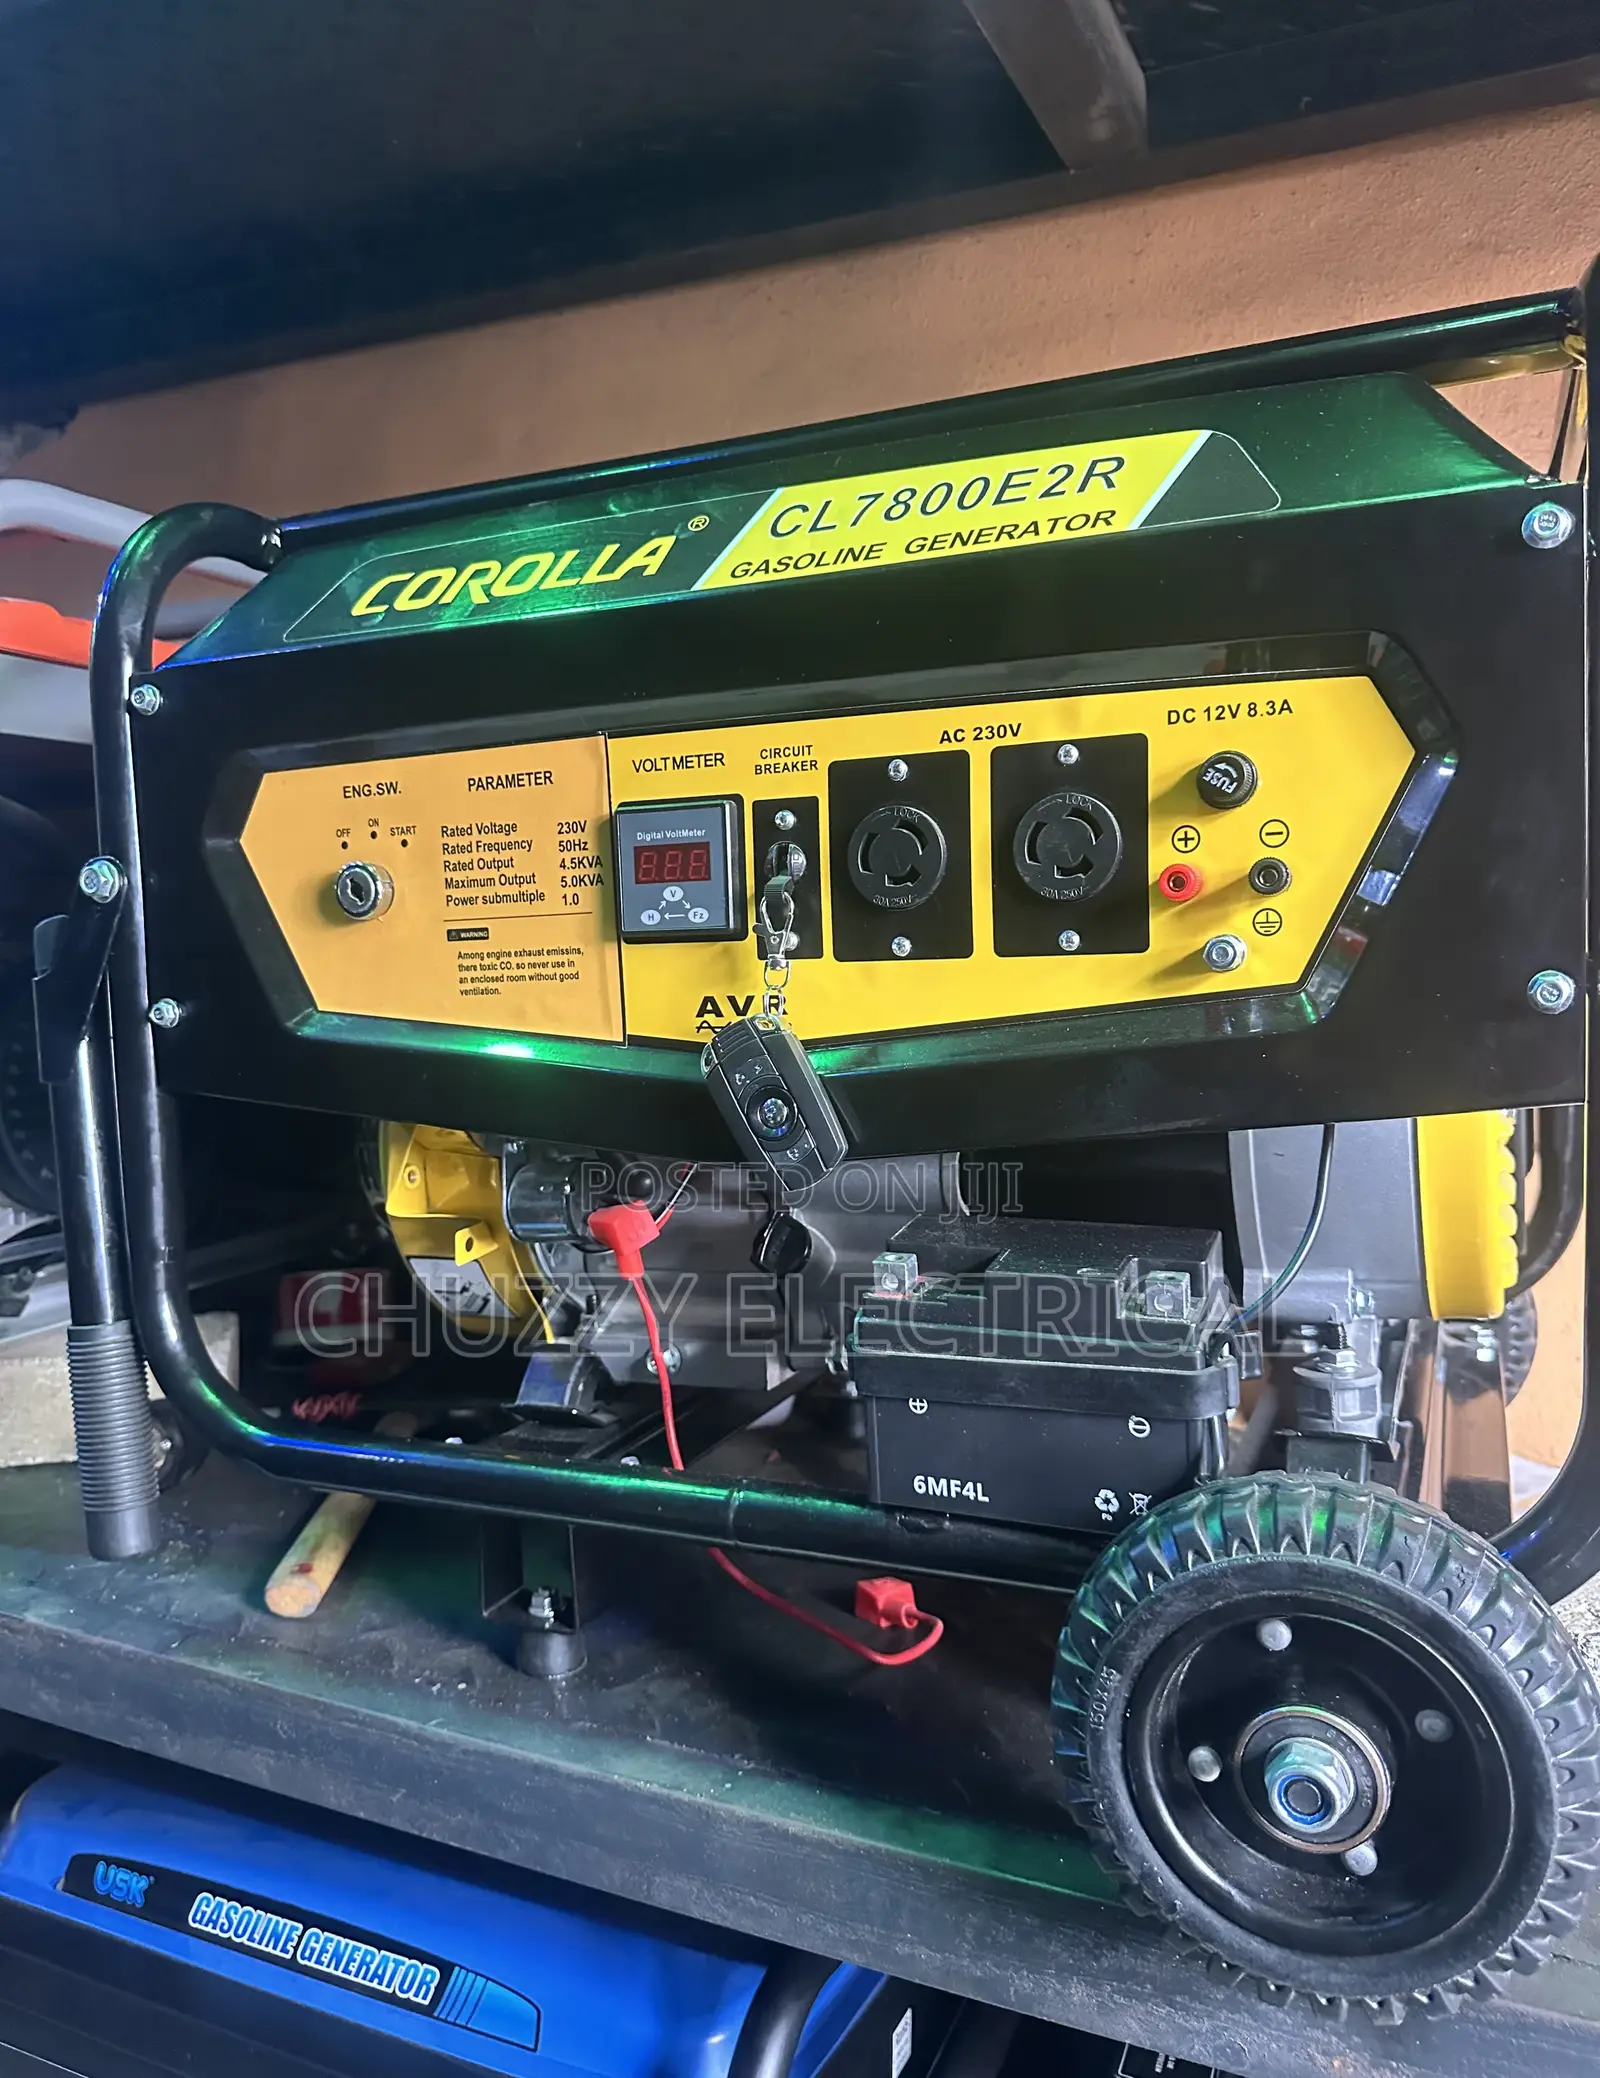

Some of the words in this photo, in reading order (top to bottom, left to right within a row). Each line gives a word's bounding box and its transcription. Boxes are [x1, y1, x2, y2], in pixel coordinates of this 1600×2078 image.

[769, 456, 1127, 539] CL7800E2R
[729, 541, 888, 580] GASOLINE
[903, 509, 1118, 555] GENERATOR
[350, 534, 677, 617] COROLLA
[1167, 708, 1196, 726] DC
[1203, 703, 1242, 722] 12V
[1247, 699, 1294, 718] 8.3A
[939, 728, 966, 745] AC
[972, 722, 1023, 742] 230V
[760, 745, 813, 760] CIRCUIT
[754, 760, 818, 775] BREAKER
[467, 770, 554, 792] PARAMETER
[1202, 767, 1239, 794] FUSE
[343, 781, 402, 799] ENG.SW.
[1065, 793, 1094, 812] LOCK
[368, 818, 380, 828] ON
[893, 806, 921, 824] LOCK
[336, 828, 351, 838] OFF
[389, 825, 417, 837] START
[441, 824, 473, 838] Rated
[475, 822, 518, 837] Voltage
[557, 820, 587, 835] 230V
[636, 832, 664, 842] Digital
[665, 829, 706, 839] VoltMeter
[442, 841, 473, 855] Rated
[475, 838, 533, 854] Frequency
[558, 839, 589, 853] 50Hz
[443, 859, 474, 873] Rated
[477, 857, 514, 872] Output
[559, 855, 603, 870] 4.5KVA
[444, 876, 496, 890] Maximum
[499, 872, 537, 888] Output
[560, 873, 604, 888] 5.0KVA
[445, 894, 479, 907] Power
[481, 889, 546, 905] submultiple
[562, 893, 579, 906] 1.0
[669, 889, 677, 898] V
[647, 913, 655, 922] H
[457, 951, 485, 961] Among
[486, 949, 512, 960] engine
[514, 947, 545, 957] exhaust
[458, 962, 478, 972] there
[479, 961, 498, 971] toxic
[516, 962, 526, 970] so
[527, 961, 549, 969] never
[551, 960, 565, 968] use
[567, 958, 575, 968] in
[459, 976, 468, 984] an
[470, 974, 504, 984] enclosed
[506, 974, 527, 982] room
[528, 971, 557, 982] without
[559, 971, 579, 982] good
[460, 986, 502, 996] ventilation.
[913, 1474, 990, 1503] 6MF4L
[93, 1860, 149, 1908] USK
[188, 1892, 304, 1960] GASOLINE
[297, 1927, 441, 2006] GENERATOR
